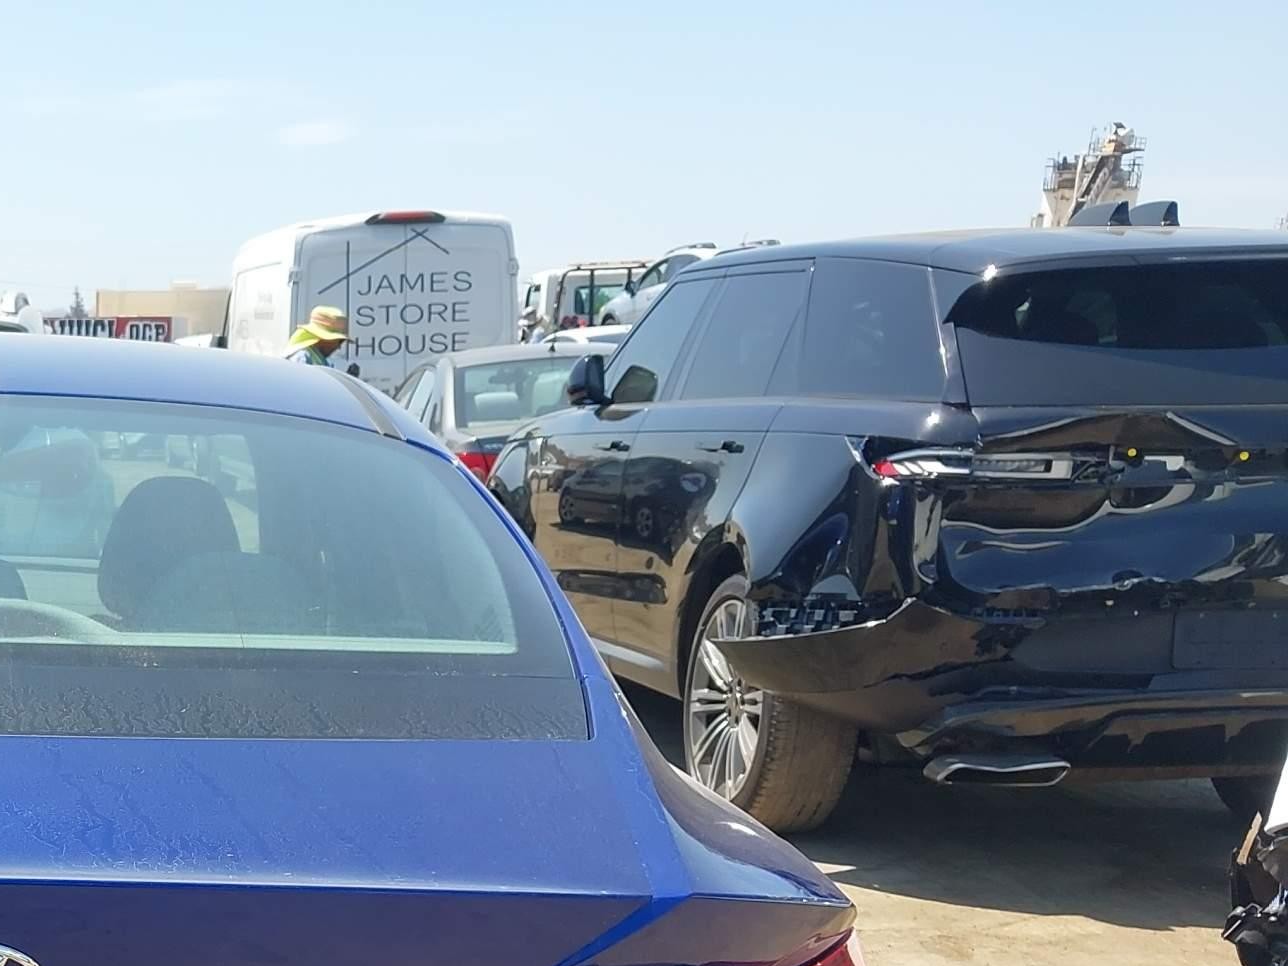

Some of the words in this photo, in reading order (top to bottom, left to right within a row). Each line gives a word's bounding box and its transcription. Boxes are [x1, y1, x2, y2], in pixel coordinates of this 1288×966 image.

[357, 271, 473, 296] JAMES
[355, 302, 471, 327] STORE
[354, 332, 470, 357] HOUSE
